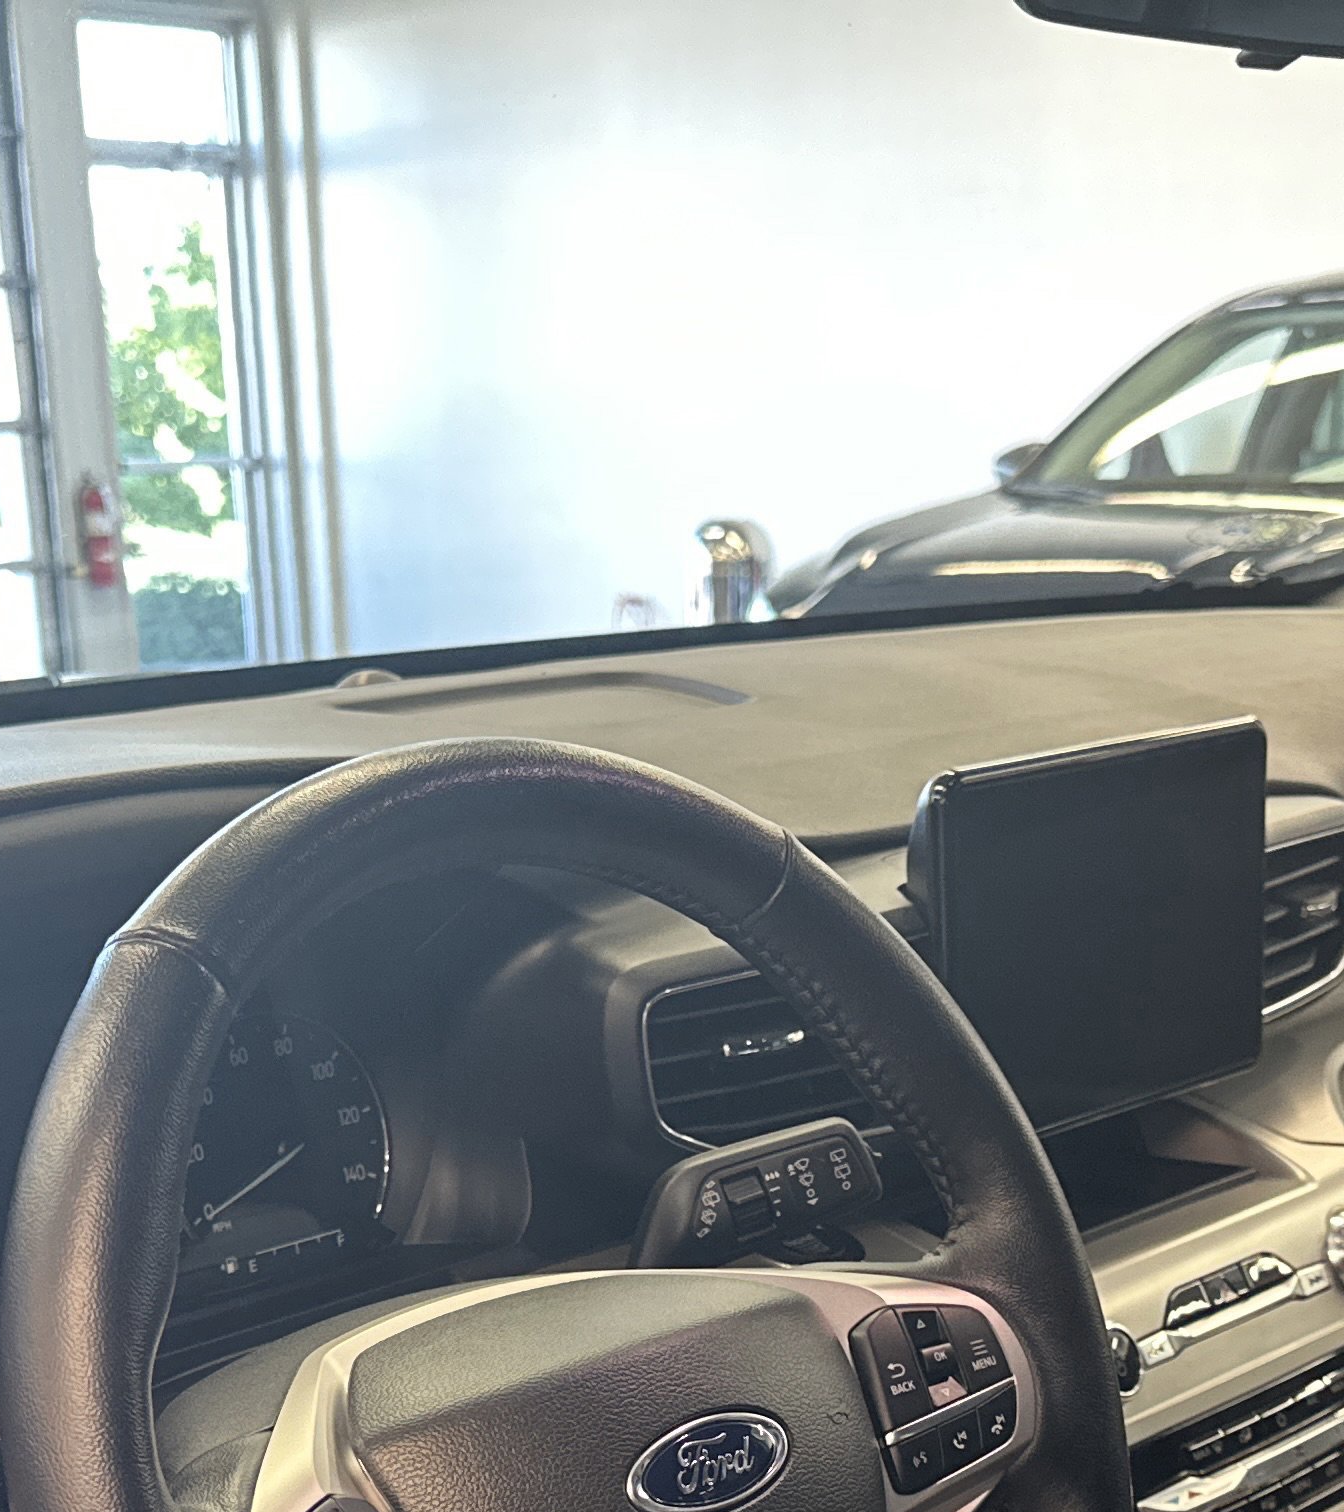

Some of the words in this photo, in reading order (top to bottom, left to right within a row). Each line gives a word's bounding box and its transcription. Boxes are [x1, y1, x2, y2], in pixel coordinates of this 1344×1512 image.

[274, 1036, 293, 1057] 80
[229, 1047, 249, 1067] 60
[310, 1060, 335, 1081] 100
[337, 1105, 361, 1127] 120
[342, 1162, 367, 1184] 140
[248, 1259, 258, 1273] E
[933, 1350, 948, 1362] OK
[971, 1355, 997, 1372] MENU
[890, 1380, 917, 1396] BACK
[677, 1432, 754, 1495] Ford
